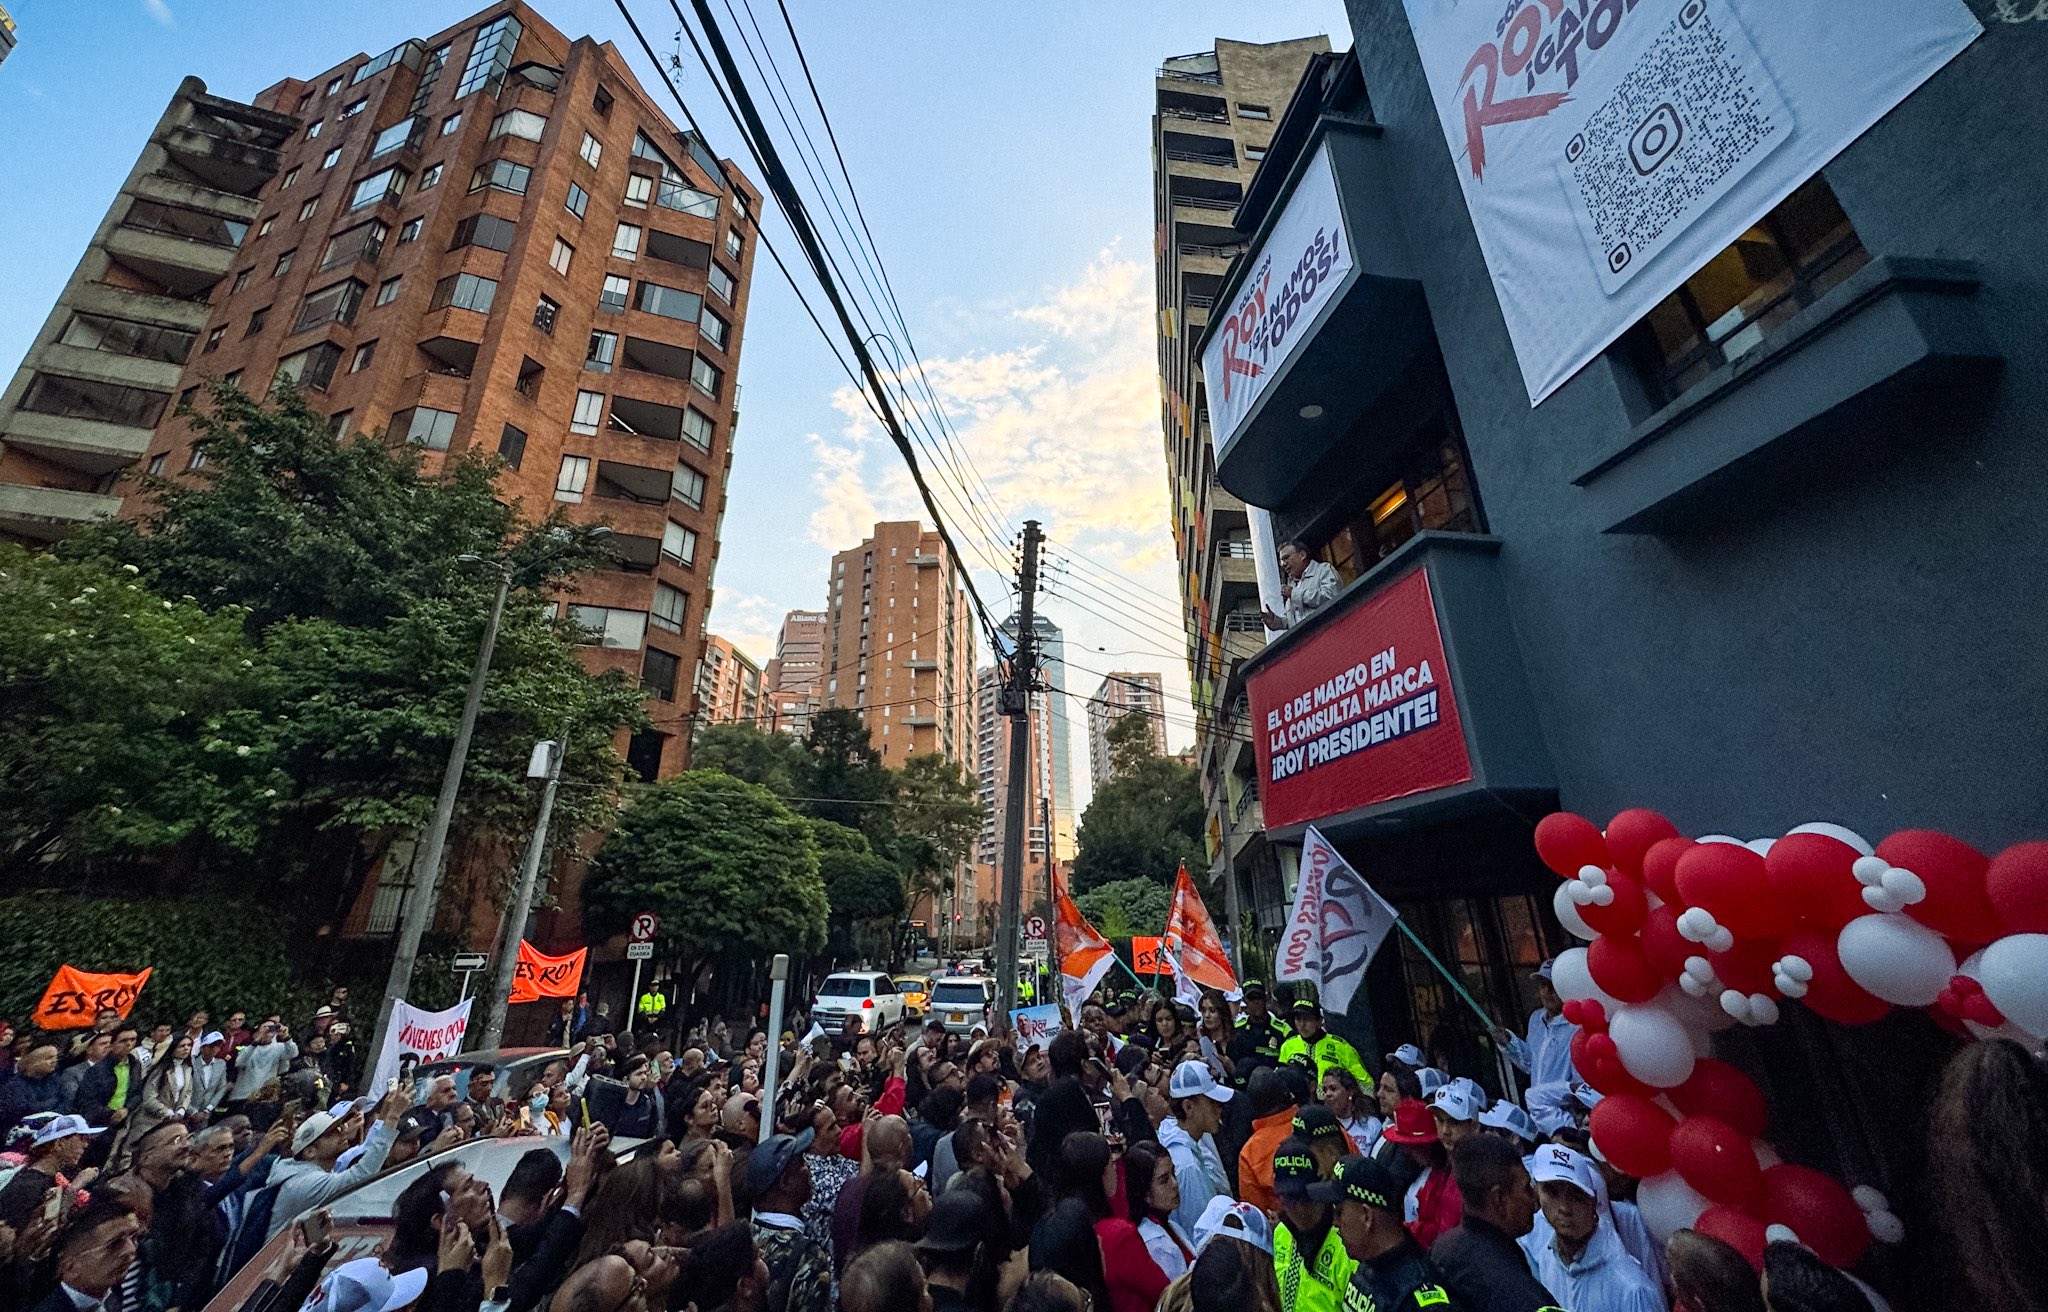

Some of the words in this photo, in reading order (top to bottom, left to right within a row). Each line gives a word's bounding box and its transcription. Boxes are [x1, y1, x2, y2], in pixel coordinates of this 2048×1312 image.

[1260, 227, 1339, 366] TODOS!
[1268, 709, 1283, 731] EL
[1284, 703, 1293, 723] 8
[1294, 691, 1312, 718] DE
[1314, 663, 1368, 708] MARZO
[1371, 646, 1396, 680] EN
[1271, 729, 1287, 752] LA
[1288, 693, 1362, 743] CONSULTA
[1364, 660, 1434, 711] MARCA
[1272, 745, 1305, 780] ¡ROY
[1308, 690, 1438, 767] PRESIDENTE!
[517, 961, 535, 981] ES
[539, 955, 580, 985] ROY
[1138, 951, 1152, 967] ES
[45, 991, 87, 1015] ES
